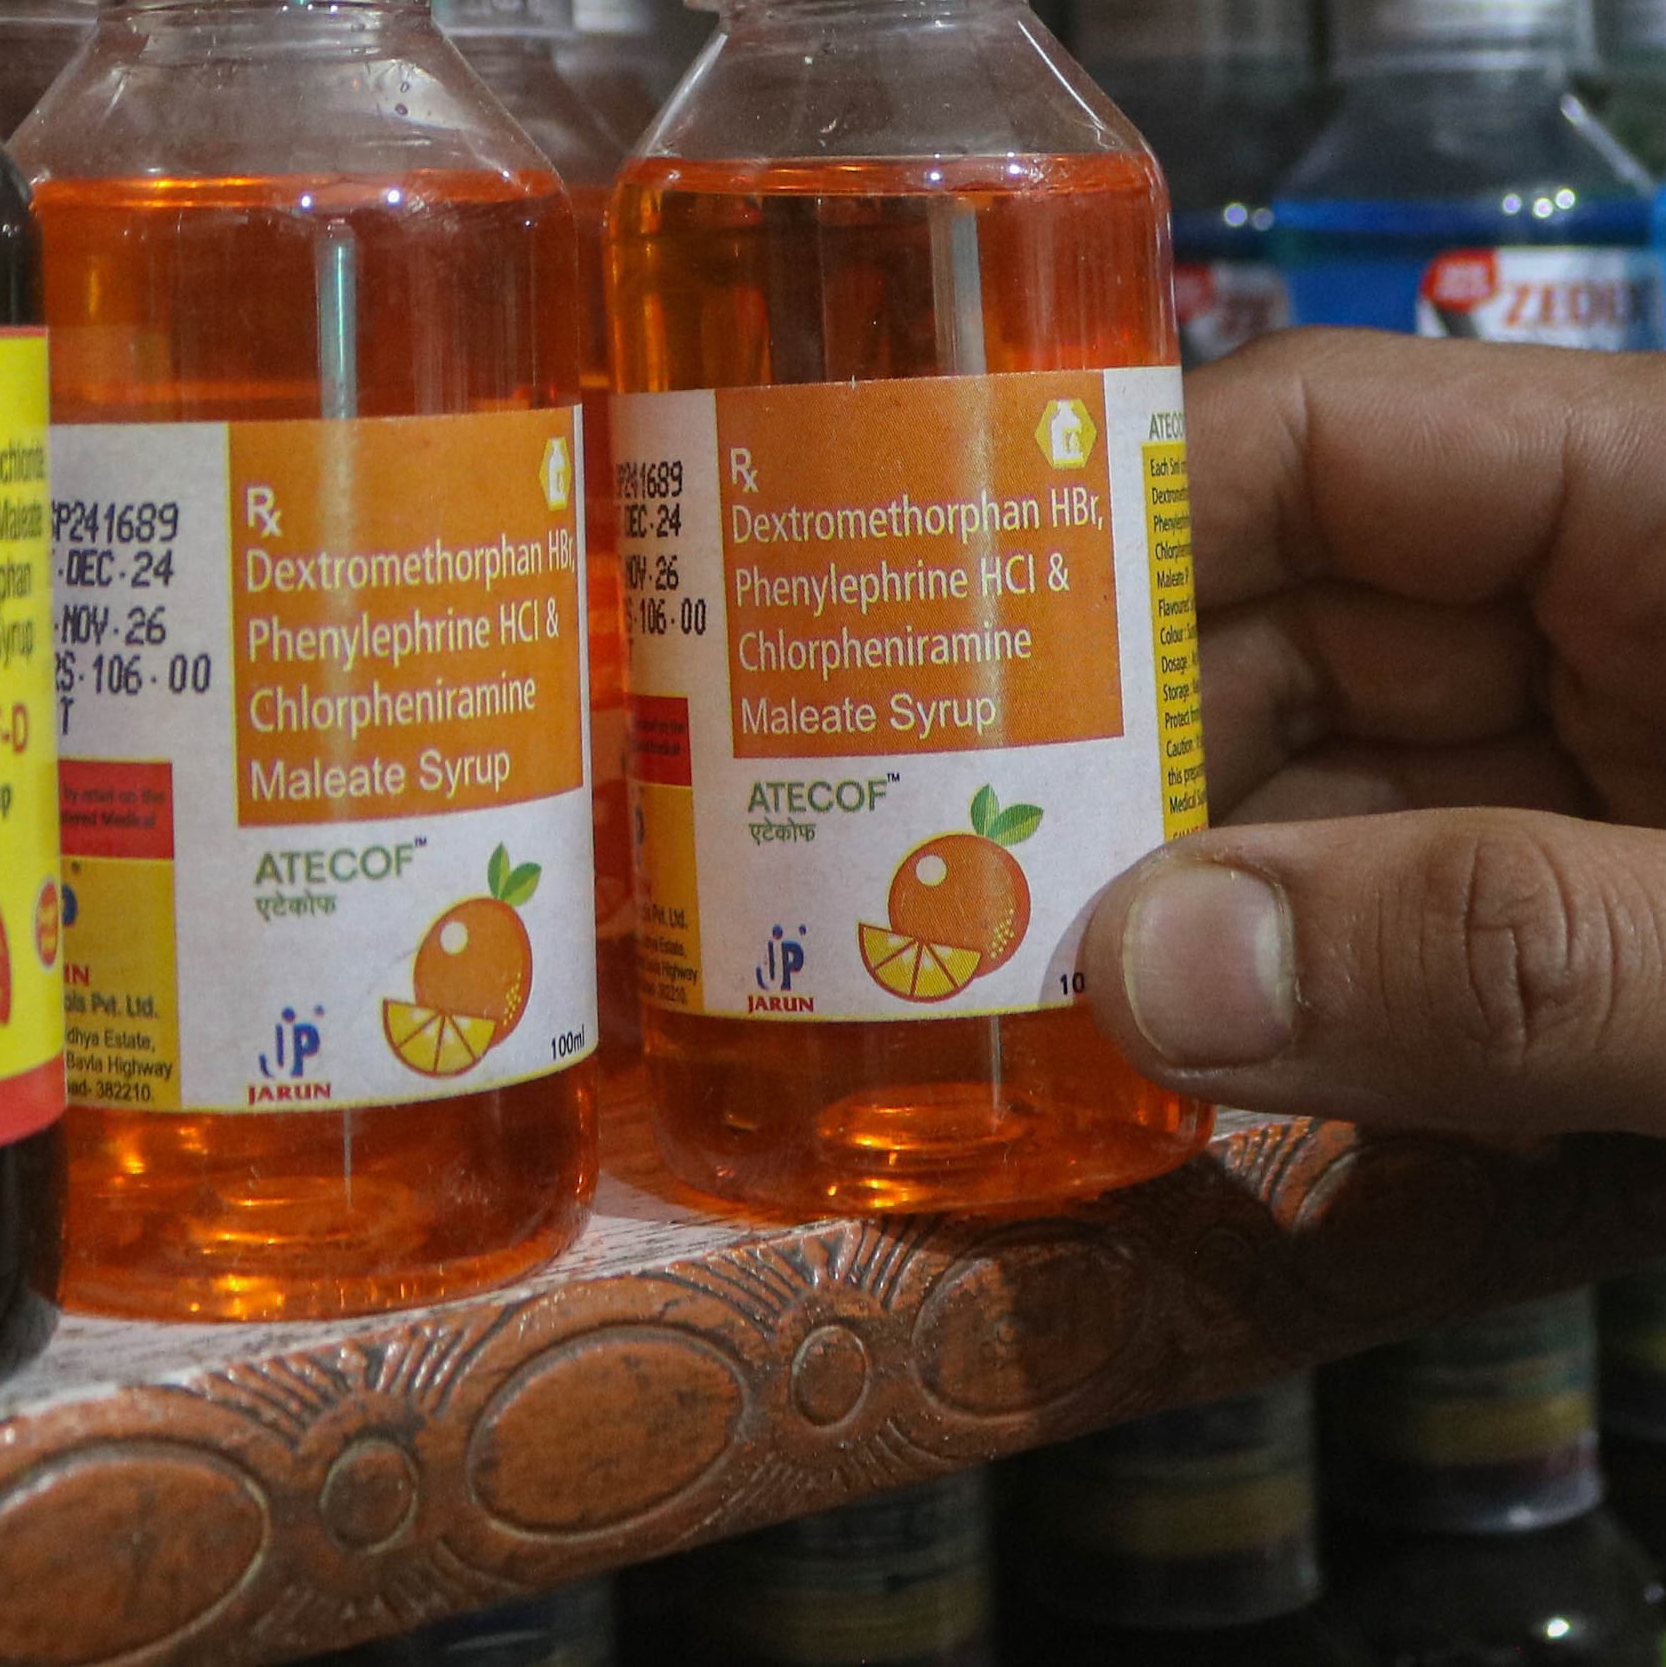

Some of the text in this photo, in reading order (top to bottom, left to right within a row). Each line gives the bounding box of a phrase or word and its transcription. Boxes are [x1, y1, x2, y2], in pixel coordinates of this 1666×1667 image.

[1150, 458, 1169, 478] Each
[733, 486, 1104, 545] Dextromethorphan HBr,
[246, 527, 576, 594] Dextromethorphan HBr,
[736, 553, 1071, 617] Phenylephrine HCl &
[248, 596, 560, 672] Phenylephrine HCl &
[739, 624, 1033, 683] Chlorpheniramine
[1161, 652, 1187, 674] Dosage
[1163, 682, 1189, 704] Storage
[249, 673, 537, 740] Chlorpheniramine
[742, 693, 997, 741] Maleate Syrup
[1165, 709, 1190, 730] Protect
[1166, 736, 1193, 759] Caution
[251, 748, 512, 802] Maleate Syrup
[1168, 766, 1183, 788] this
[1169, 792, 1197, 816] Medical
[1059, 972, 1086, 996] 10
[126, 993, 159, 1019] Ltd.
[747, 993, 815, 1014] JARUN
[104, 1028, 156, 1054] Estate,
[549, 1022, 586, 1062] 100ml
[108, 1052, 173, 1082] Highway
[248, 1082, 333, 1105] JARUN
